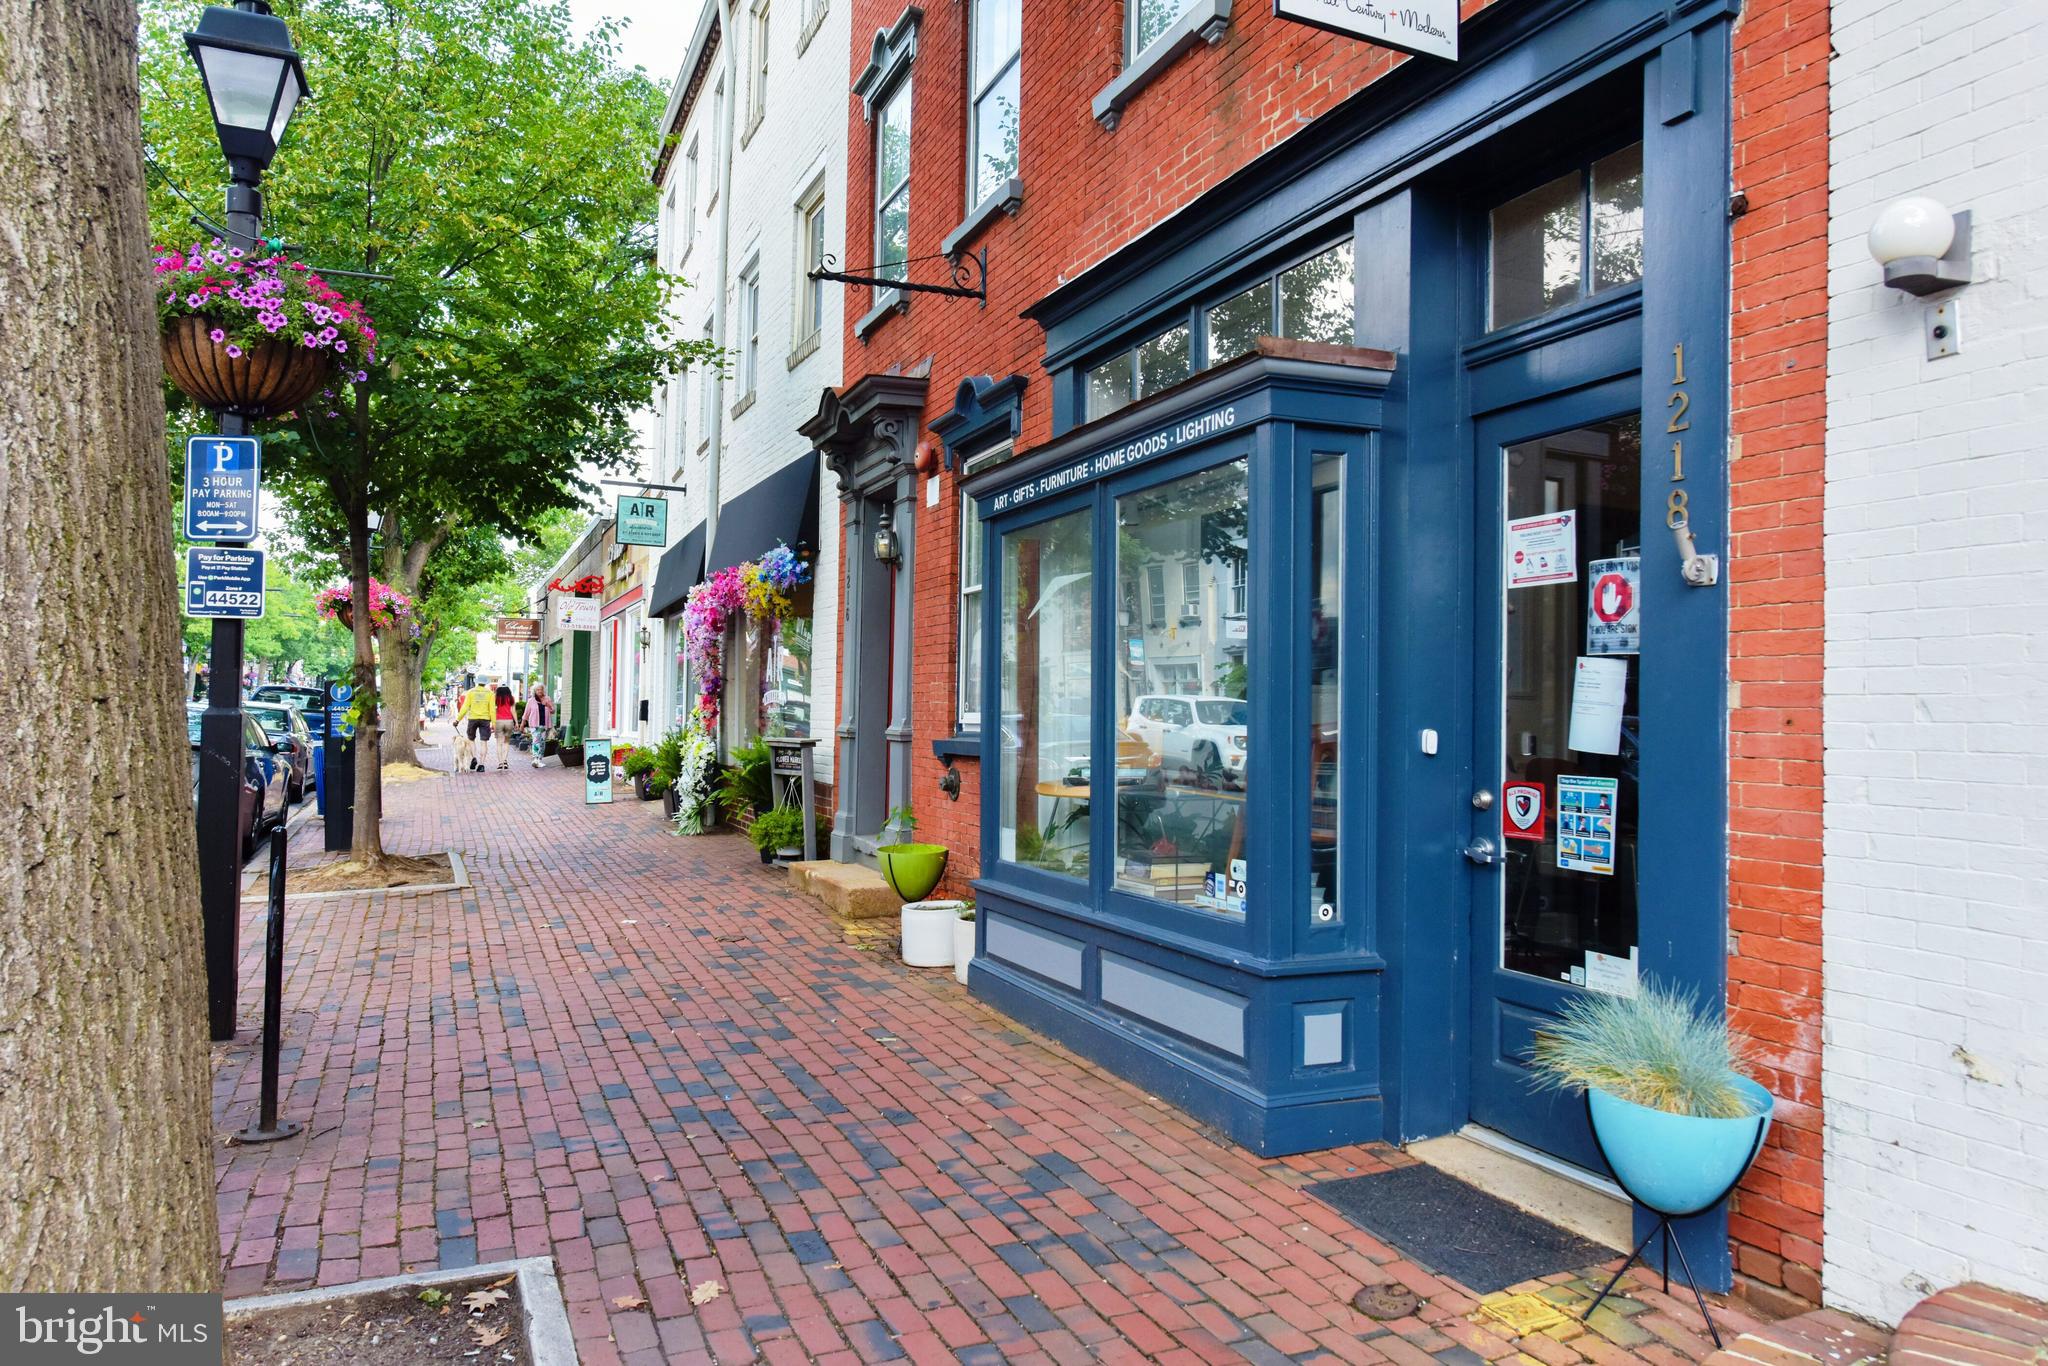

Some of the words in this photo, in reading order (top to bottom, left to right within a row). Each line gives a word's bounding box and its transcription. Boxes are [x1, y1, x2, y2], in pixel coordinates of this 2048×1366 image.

[1400, 9, 1446, 39] Modern
[1667, 342, 1690, 530] 1218
[993, 497, 1008, 511] ART
[1013, 485, 1035, 504] GIFTS
[1040, 463, 1089, 492] FURNITURE
[1095, 449, 1125, 473] HOME
[1126, 432, 1167, 461] GOODS
[1176, 407, 1235, 444] LIGHTING
[203, 477, 210, 487] 3
[212, 477, 242, 487] HOUR
[192, 488, 210, 498] PAY
[213, 489, 252, 498] PARKING
[198, 553, 212, 561] Pay
[225, 555, 255, 563] Parking
[208, 593, 258, 605] 44522
